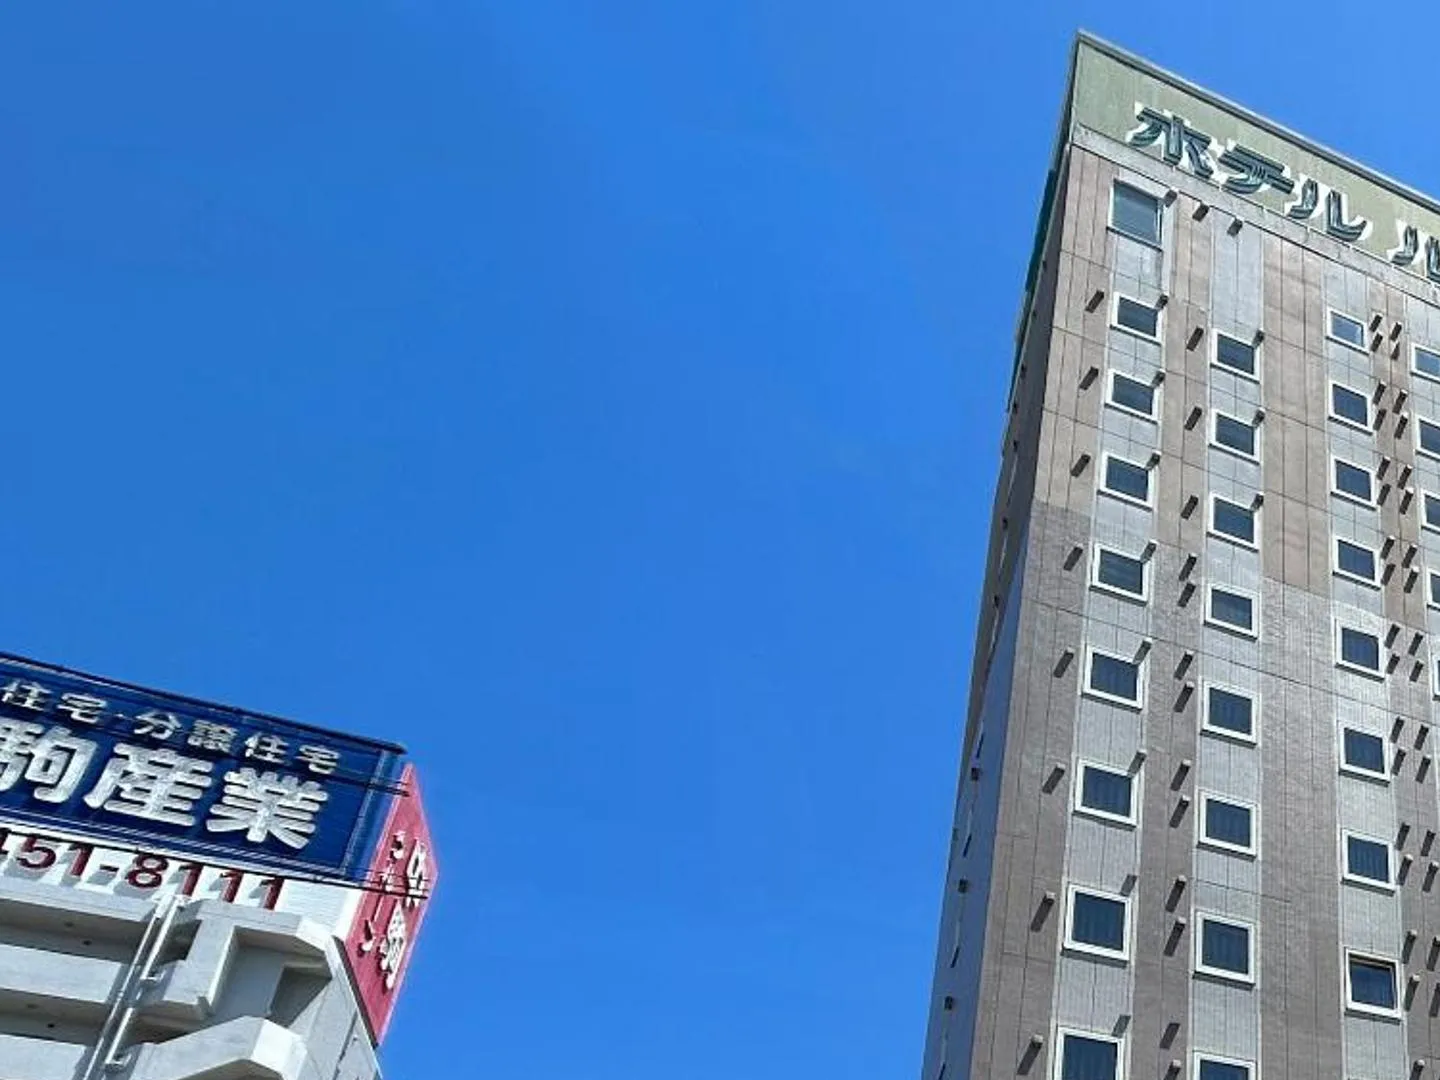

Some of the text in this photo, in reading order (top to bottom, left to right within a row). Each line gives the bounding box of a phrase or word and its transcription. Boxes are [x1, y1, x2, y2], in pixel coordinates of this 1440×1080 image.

[1126, 104, 1371, 244] ホテル
[0, 717, 329, 849] 駒産業
[0, 828, 285, 911] 51-8111
